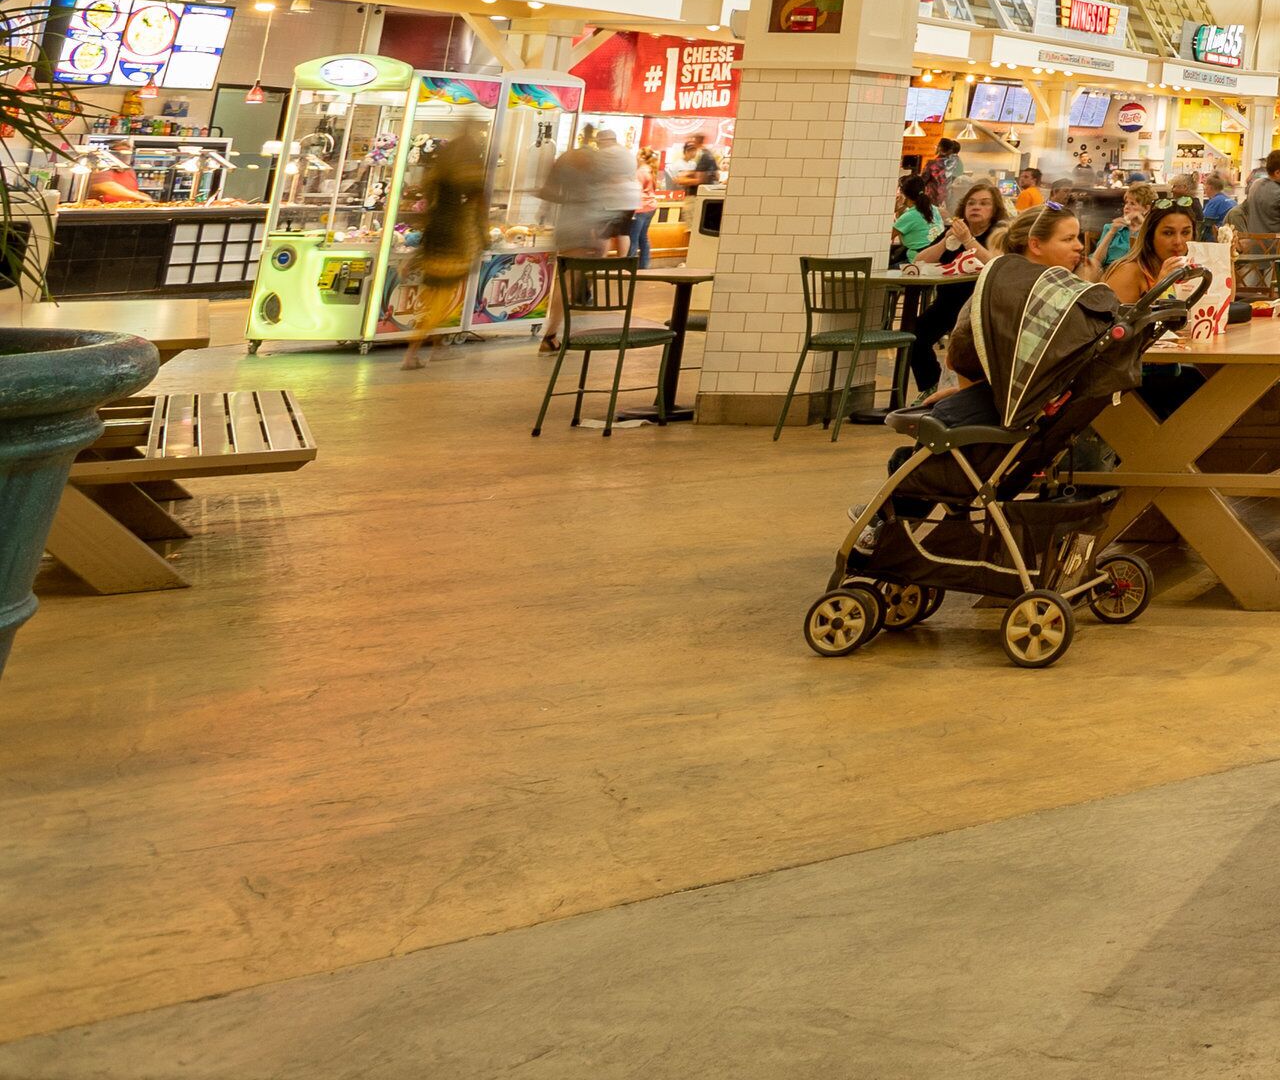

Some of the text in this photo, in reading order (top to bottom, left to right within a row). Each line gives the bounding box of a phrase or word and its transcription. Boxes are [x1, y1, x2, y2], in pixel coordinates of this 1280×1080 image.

[1224, 25, 1244, 57] 55
[683, 46, 735, 64] CHEESE
[644, 48, 679, 111] #1
[681, 63, 732, 83] STEAK
[679, 89, 730, 110] WORLD
